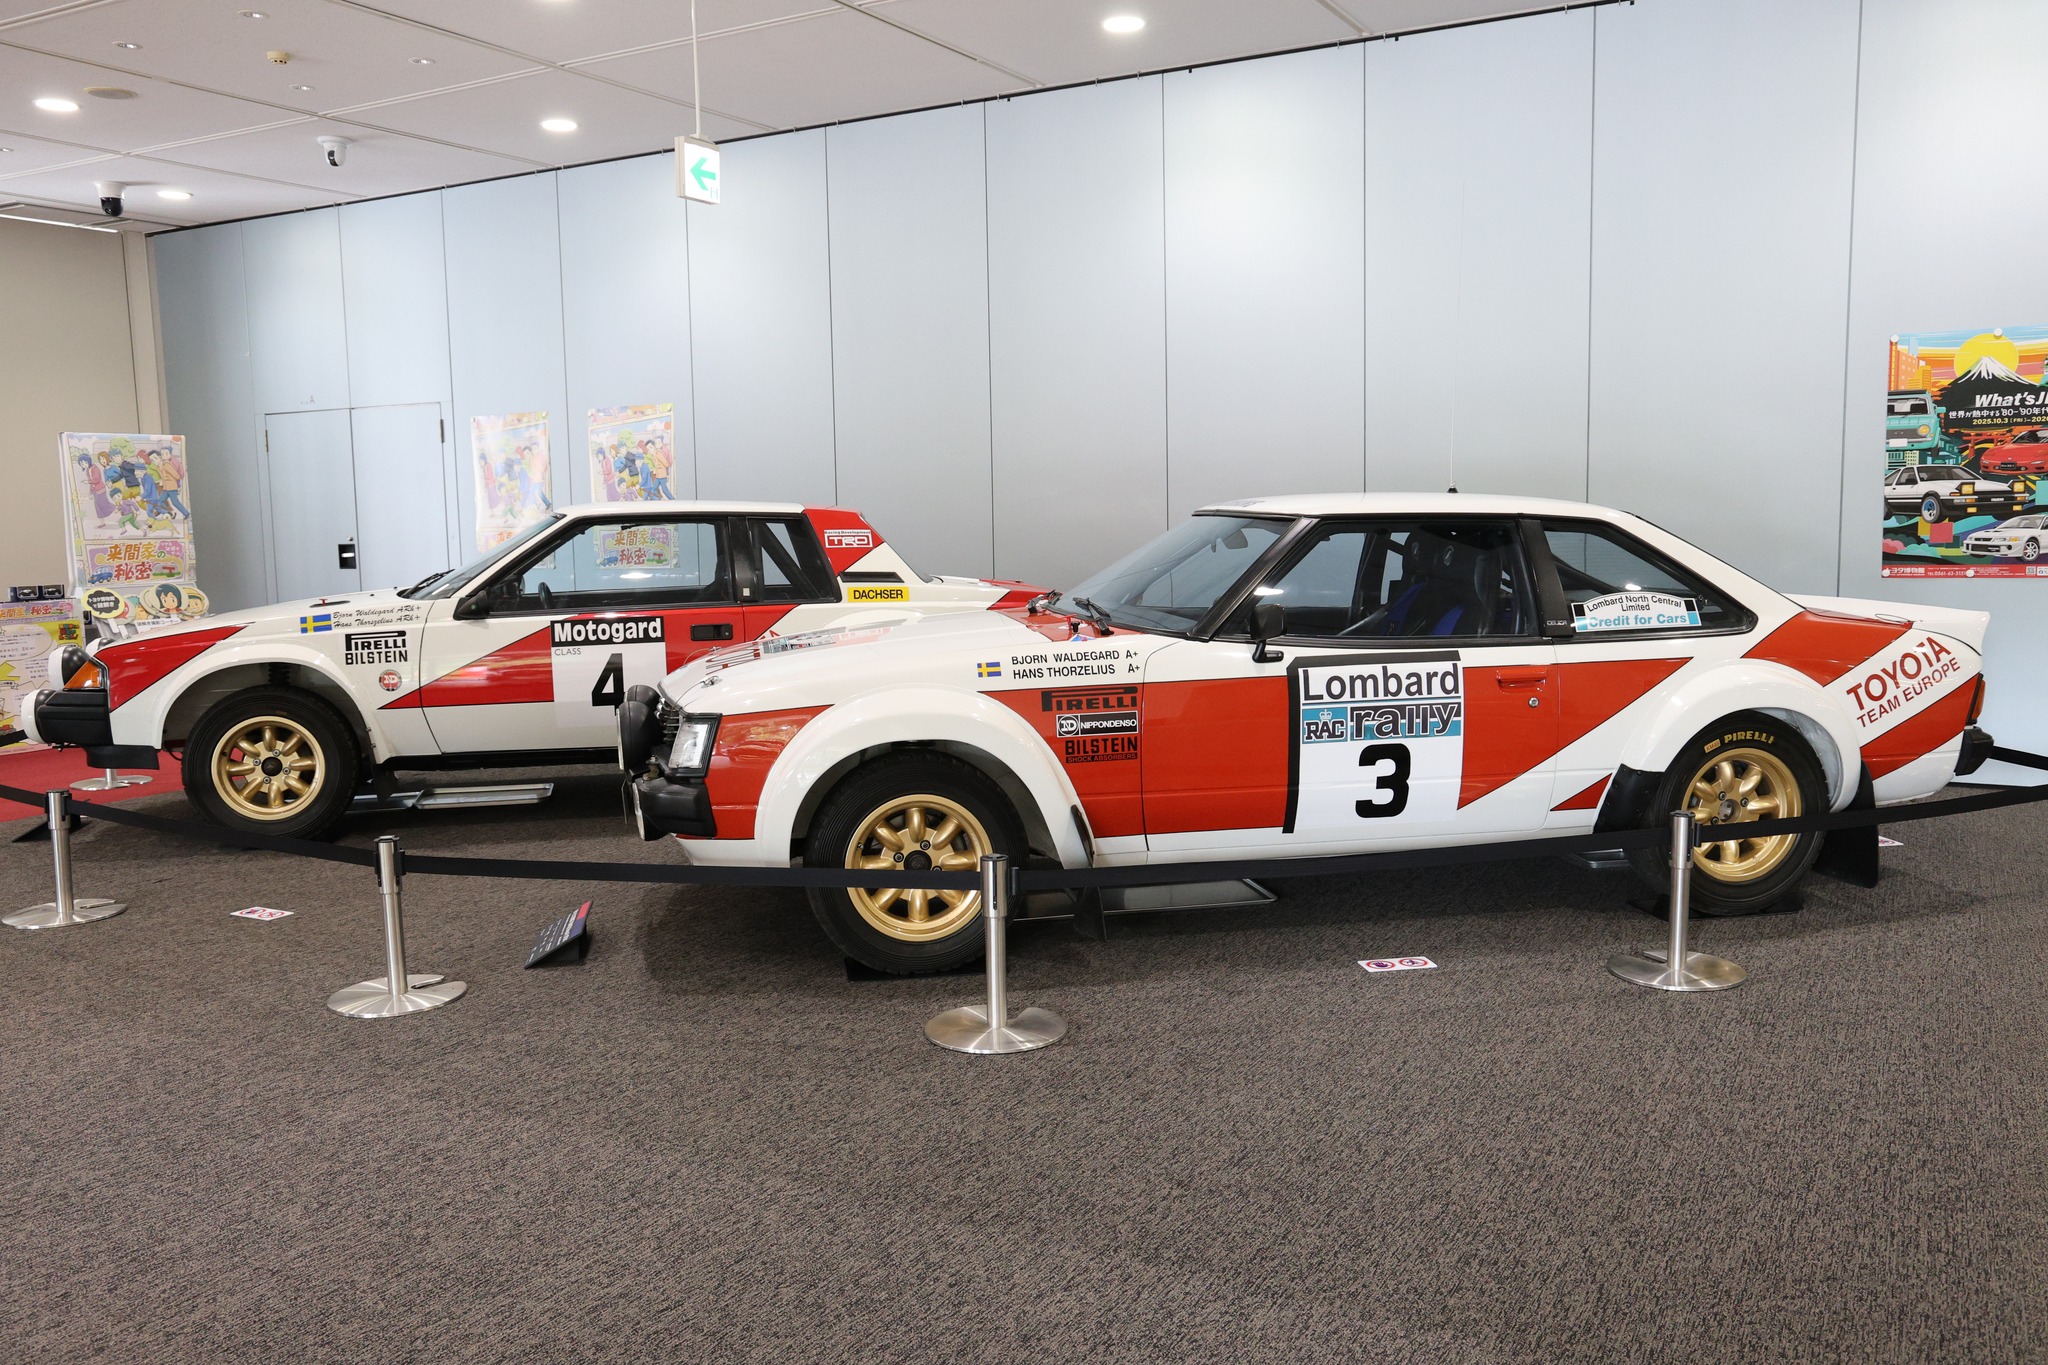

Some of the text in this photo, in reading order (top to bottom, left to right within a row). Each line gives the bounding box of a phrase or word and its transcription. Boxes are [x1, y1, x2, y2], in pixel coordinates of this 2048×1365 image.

[1972, 417, 2009, 425] 2025.10.3
[619, 547, 647, 565] 秘密
[113, 561, 153, 581] 秘密
[853, 589, 904, 600] DACHSER
[1586, 595, 1682, 612] Lombard North Central
[1620, 603, 1651, 612] Limited
[333, 620, 353, 628] Hans
[1589, 613, 1688, 628] Credit for Cars
[554, 617, 662, 643] Motogard
[345, 630, 407, 651] PIRELLI
[345, 650, 408, 665] BILSTEIN
[554, 648, 582, 656] CLASS
[1011, 649, 1139, 665] BJORN WALDEGARD A+
[1013, 663, 1141, 680] HANS THORZELIUS A+
[1846, 636, 1952, 711] TOYOTA
[1902, 657, 1961, 702] EUROPE
[591, 653, 625, 716] 4
[1302, 663, 1460, 701] Lombard
[1040, 686, 1139, 712] PIRELLI
[1856, 695, 1901, 728] TEAM
[1080, 718, 1138, 730] NIPPONDENSO
[1304, 703, 1458, 741] RAC rally
[1065, 736, 1138, 756] BILSTEIN
[1723, 731, 1775, 745] PIRELLI
[1067, 752, 1137, 763] SHOCK ABSORBERS
[1355, 743, 1411, 818] 3
